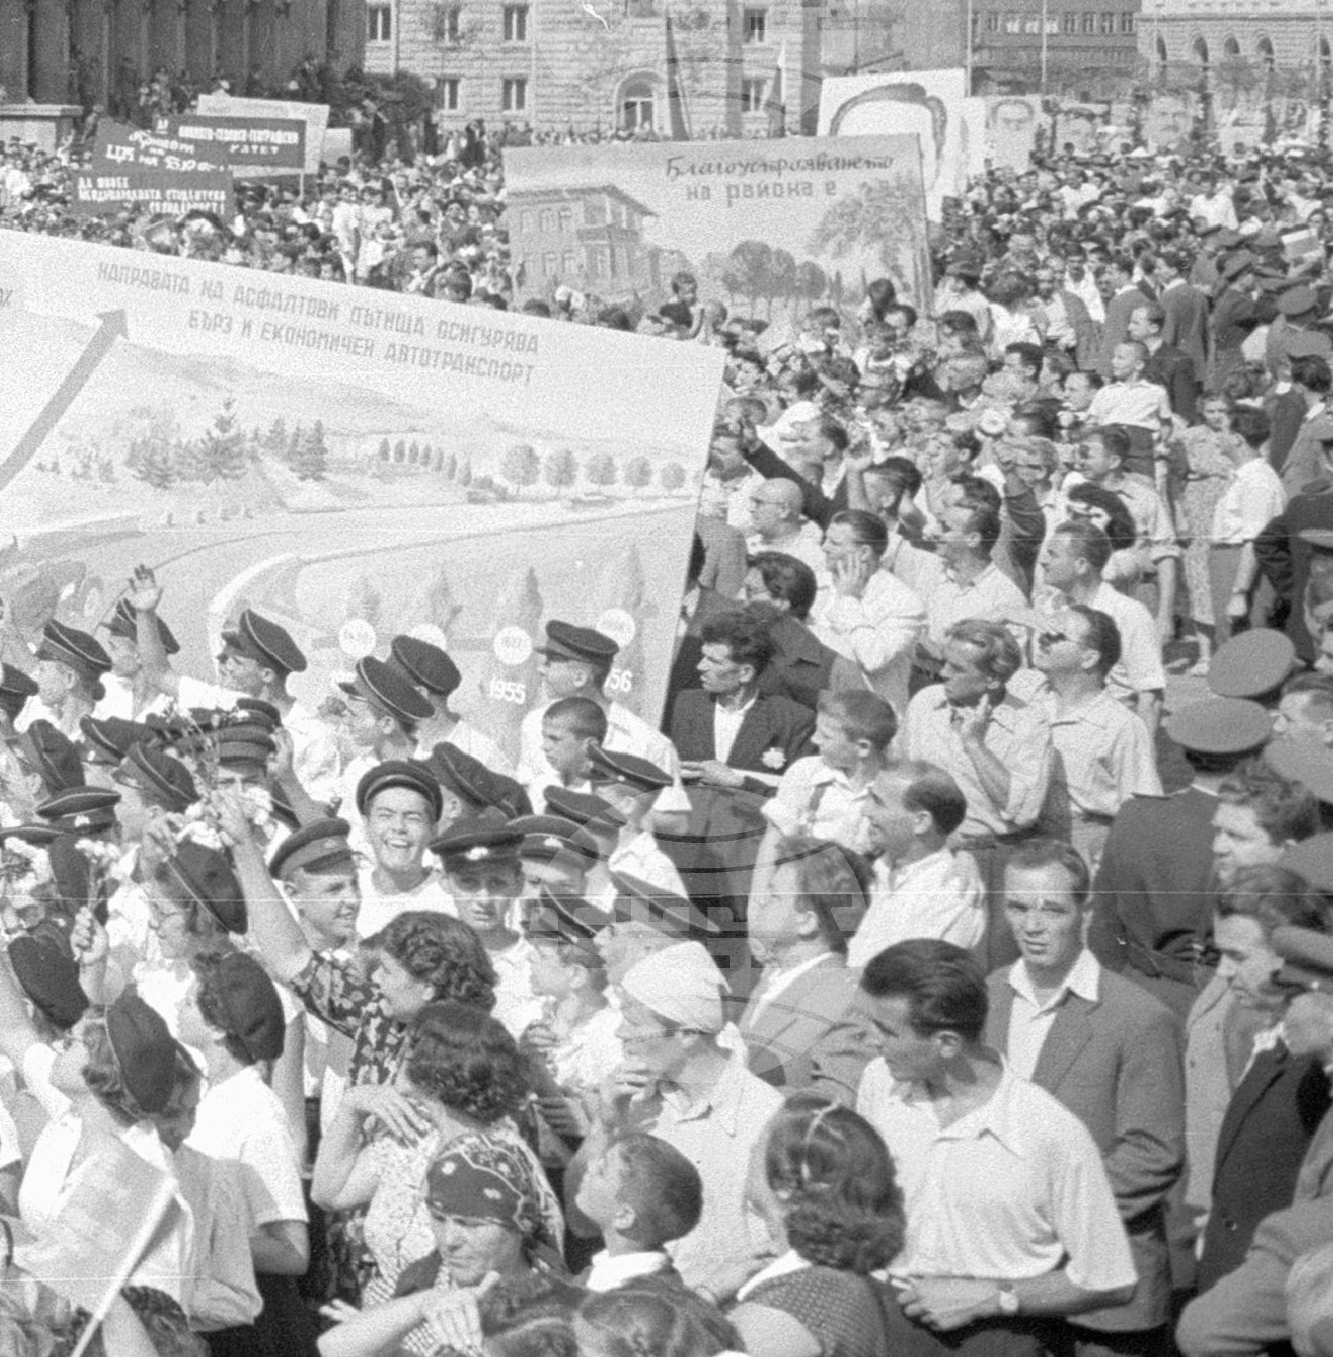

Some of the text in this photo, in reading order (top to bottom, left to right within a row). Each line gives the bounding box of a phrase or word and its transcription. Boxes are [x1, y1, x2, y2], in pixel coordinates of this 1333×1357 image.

[686, 185, 711, 200] на
[97, 261, 190, 295] НАПРАВАТА
[200, 279, 224, 300] НА
[187, 309, 535, 384] БЪРЗ И ЕКОНОМИЧЕН АВТОТРАНСПОРТ
[487, 677, 526, 705] 1955
